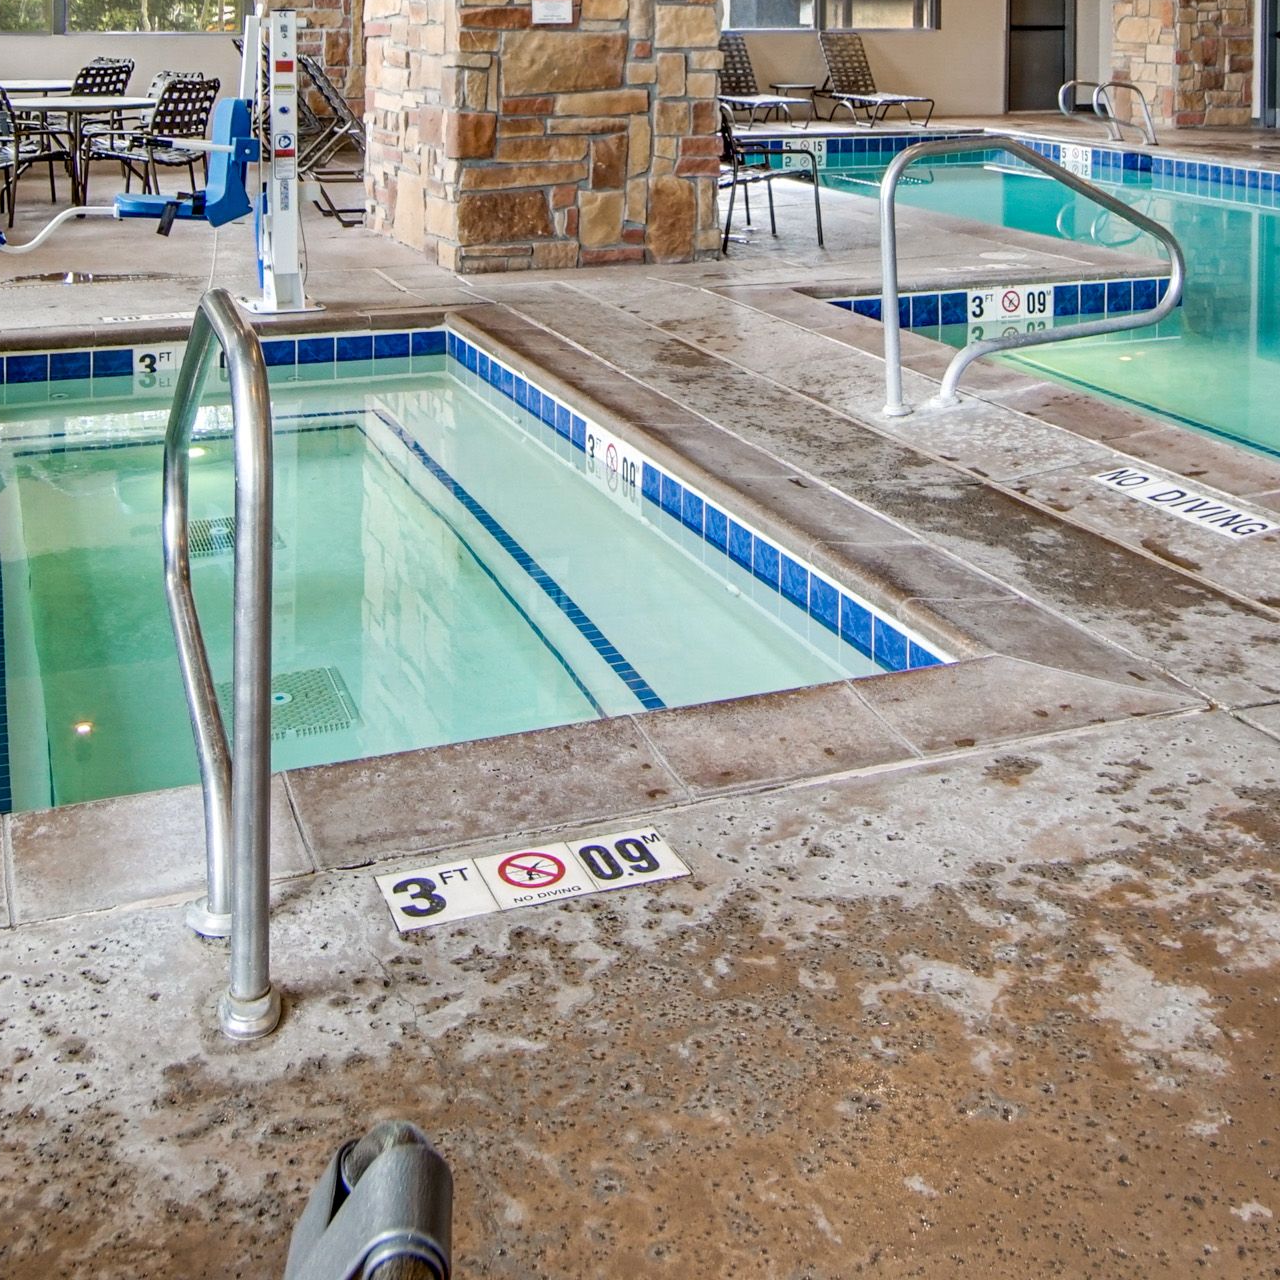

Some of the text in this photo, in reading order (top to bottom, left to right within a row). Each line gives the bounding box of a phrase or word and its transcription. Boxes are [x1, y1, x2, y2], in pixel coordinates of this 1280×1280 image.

[971, 295, 984, 318] 3
[985, 294, 994, 302] FT
[138, 352, 173, 374] 3 FT
[1098, 469, 1269, 535] NO DIVING
[392, 877, 447, 918] 3
[438, 867, 469, 885] FT
[513, 885, 582, 905] NO DIVING
